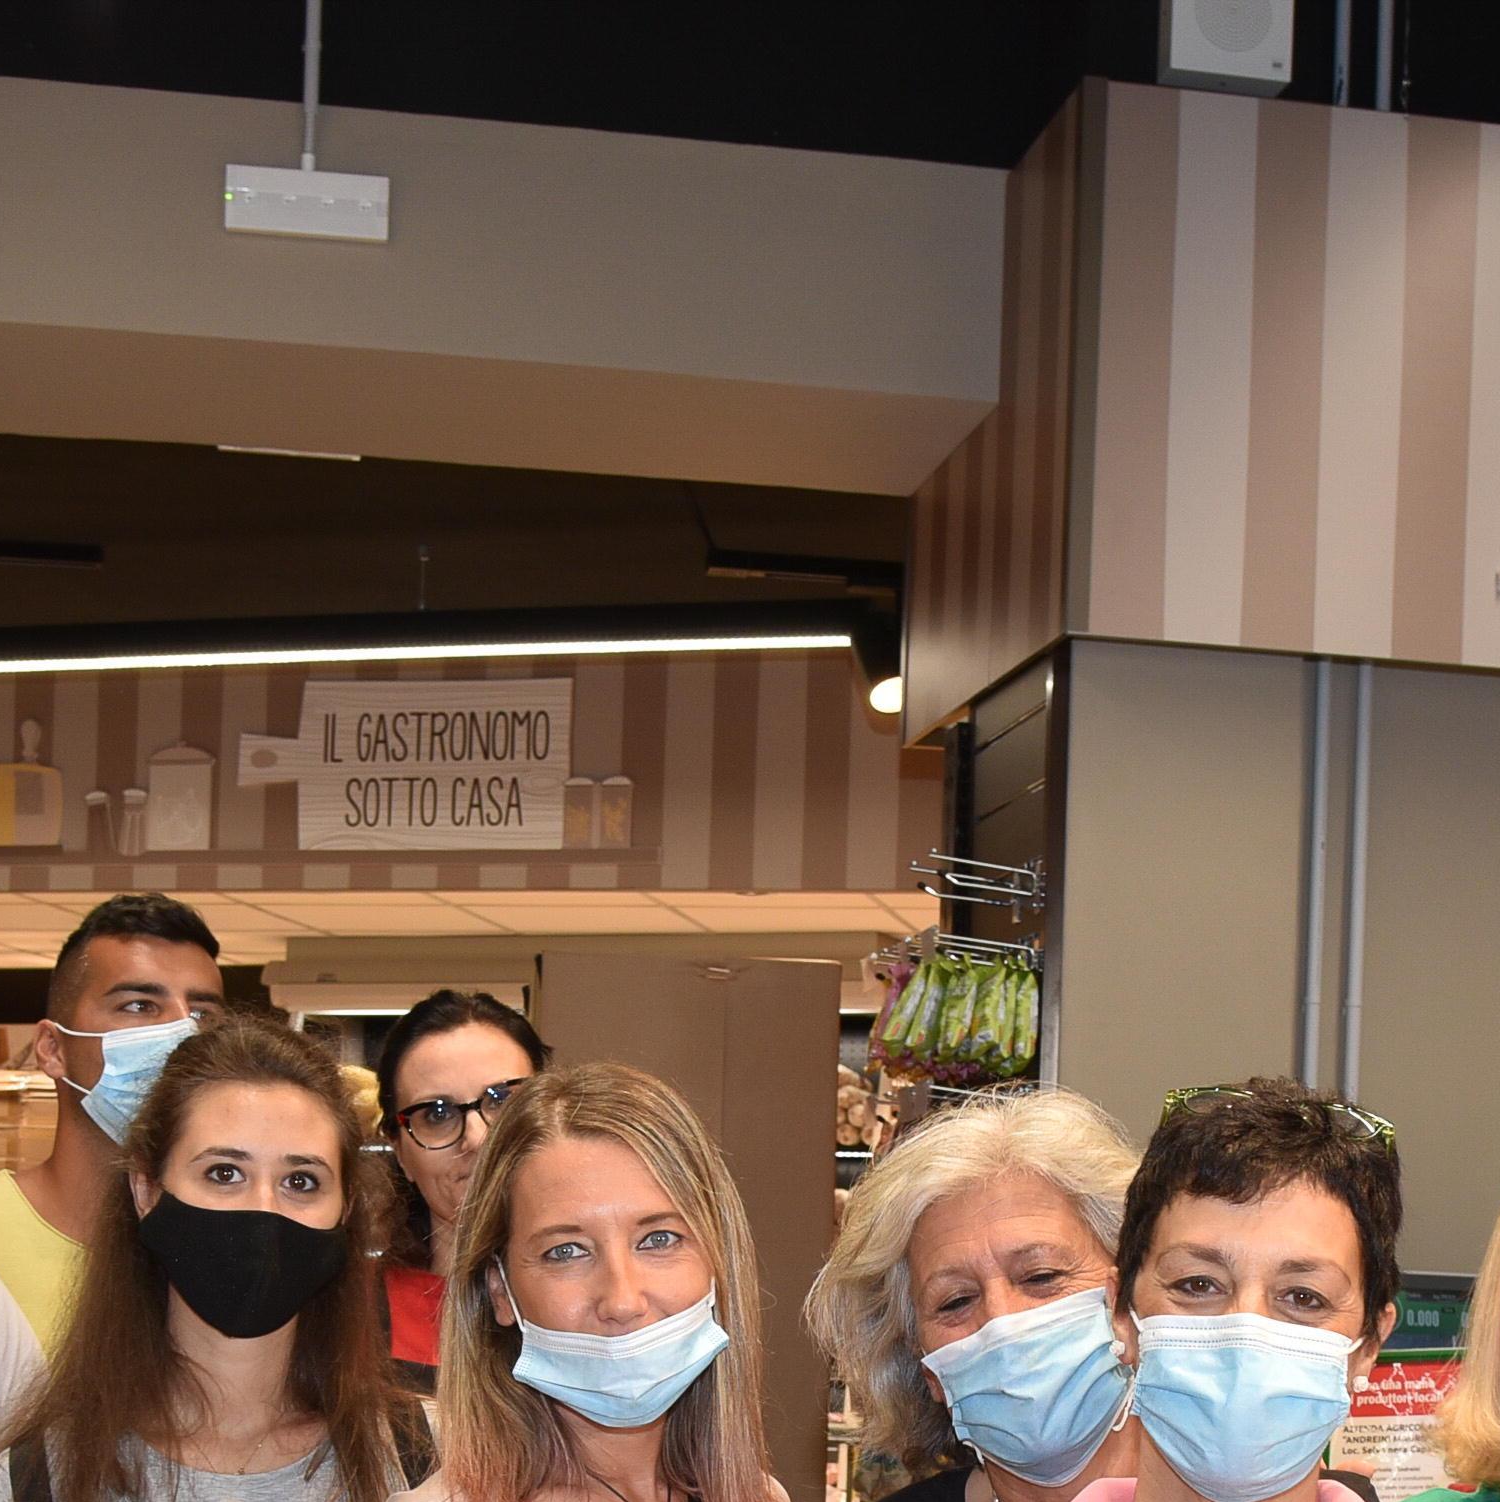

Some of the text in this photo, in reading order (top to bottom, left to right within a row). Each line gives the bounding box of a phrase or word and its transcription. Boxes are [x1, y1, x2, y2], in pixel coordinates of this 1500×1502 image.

[322, 709, 550, 764] IL GASTRONOMO
[344, 776, 524, 828] SOTTO CASA
